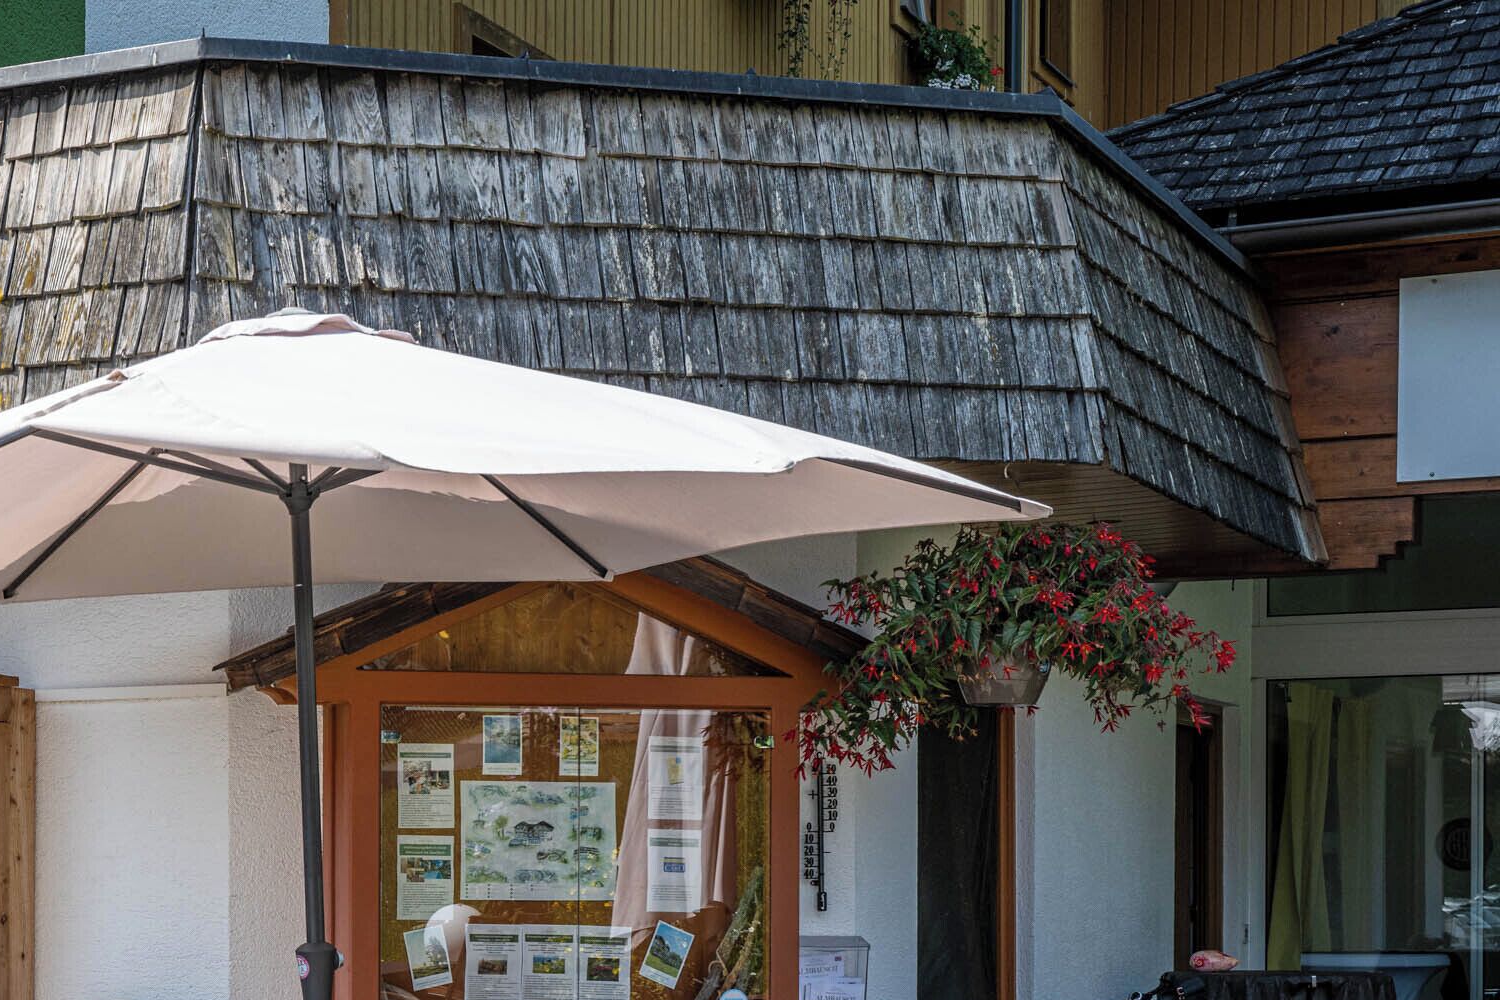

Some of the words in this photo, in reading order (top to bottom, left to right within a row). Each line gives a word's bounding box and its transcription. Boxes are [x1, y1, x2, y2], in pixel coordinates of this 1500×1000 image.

[826, 775, 837, 785] 40
[827, 787, 838, 797] 30
[827, 798, 838, 809] 20
[828, 810, 838, 820] 10
[806, 822, 812, 832] 0
[829, 822, 835, 832] 0
[804, 833, 814, 844] 10
[804, 845, 814, 855] 20
[804, 857, 814, 867] 30
[804, 869, 814, 879] 40
